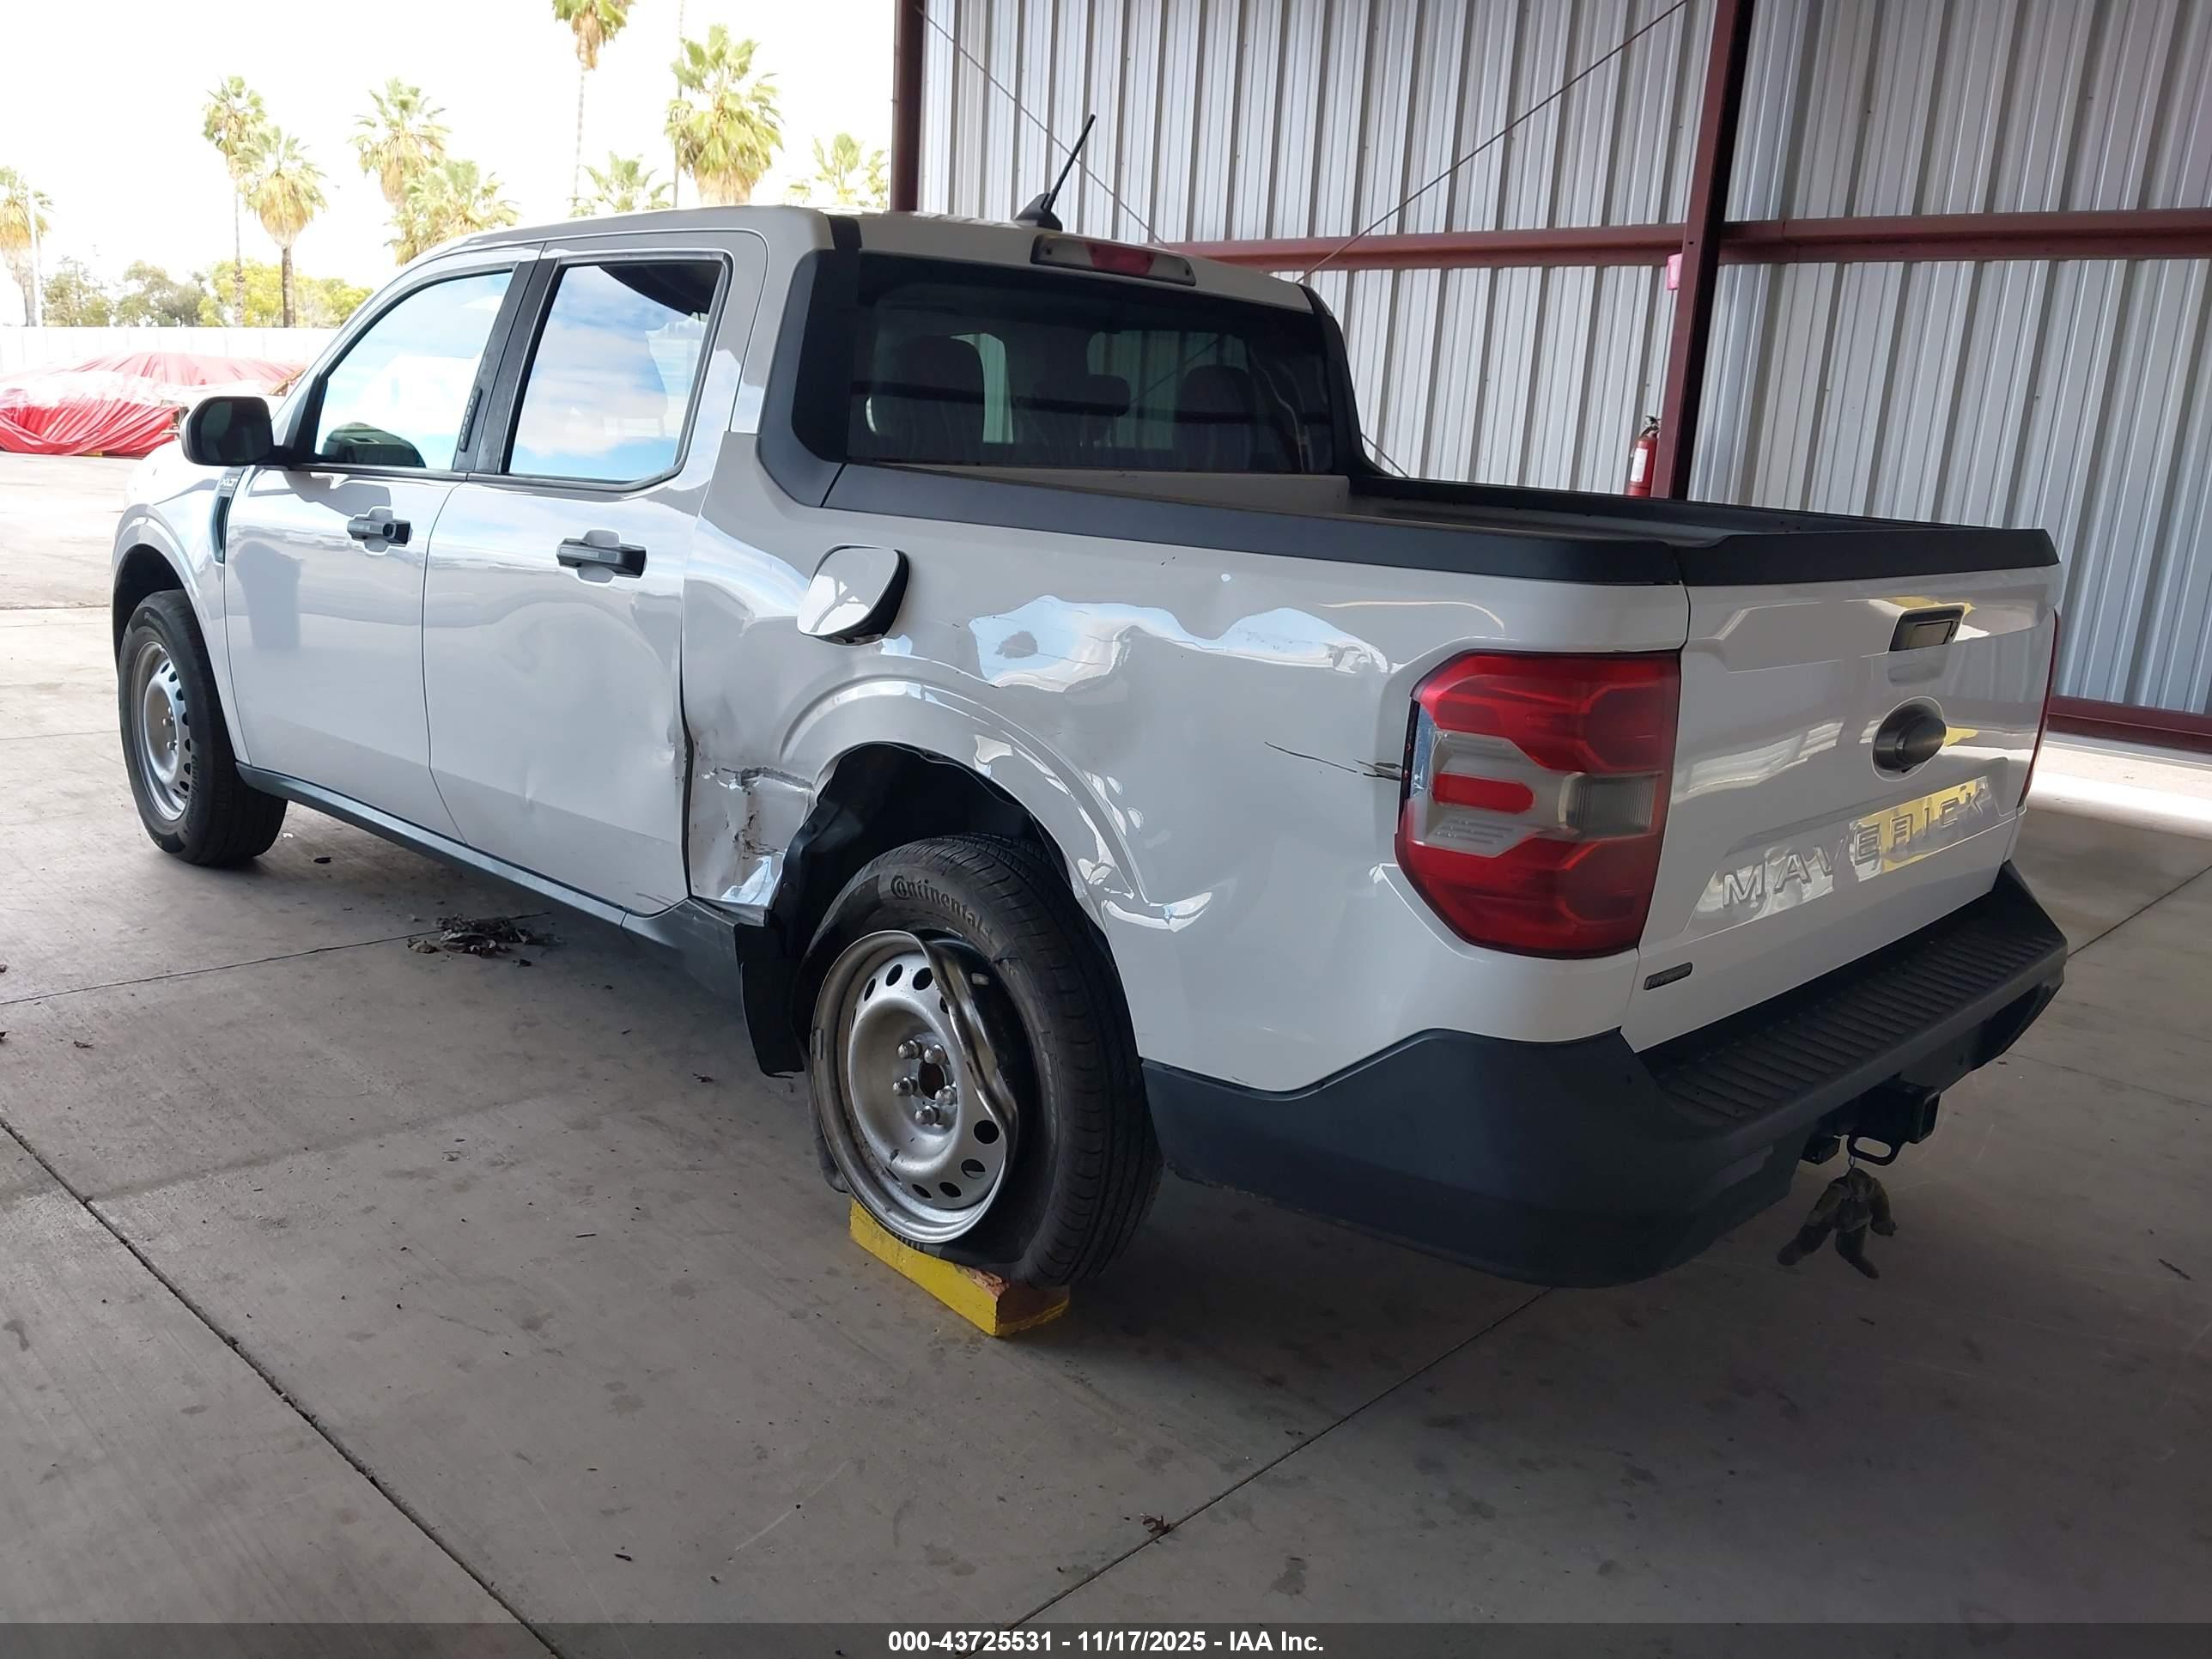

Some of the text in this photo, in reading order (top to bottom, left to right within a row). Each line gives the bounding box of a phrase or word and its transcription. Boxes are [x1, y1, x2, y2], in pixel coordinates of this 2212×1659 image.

[219, 477, 239, 487] XLT
[1722, 787, 1984, 908] MAVERICK
[890, 875, 983, 933] Continental
